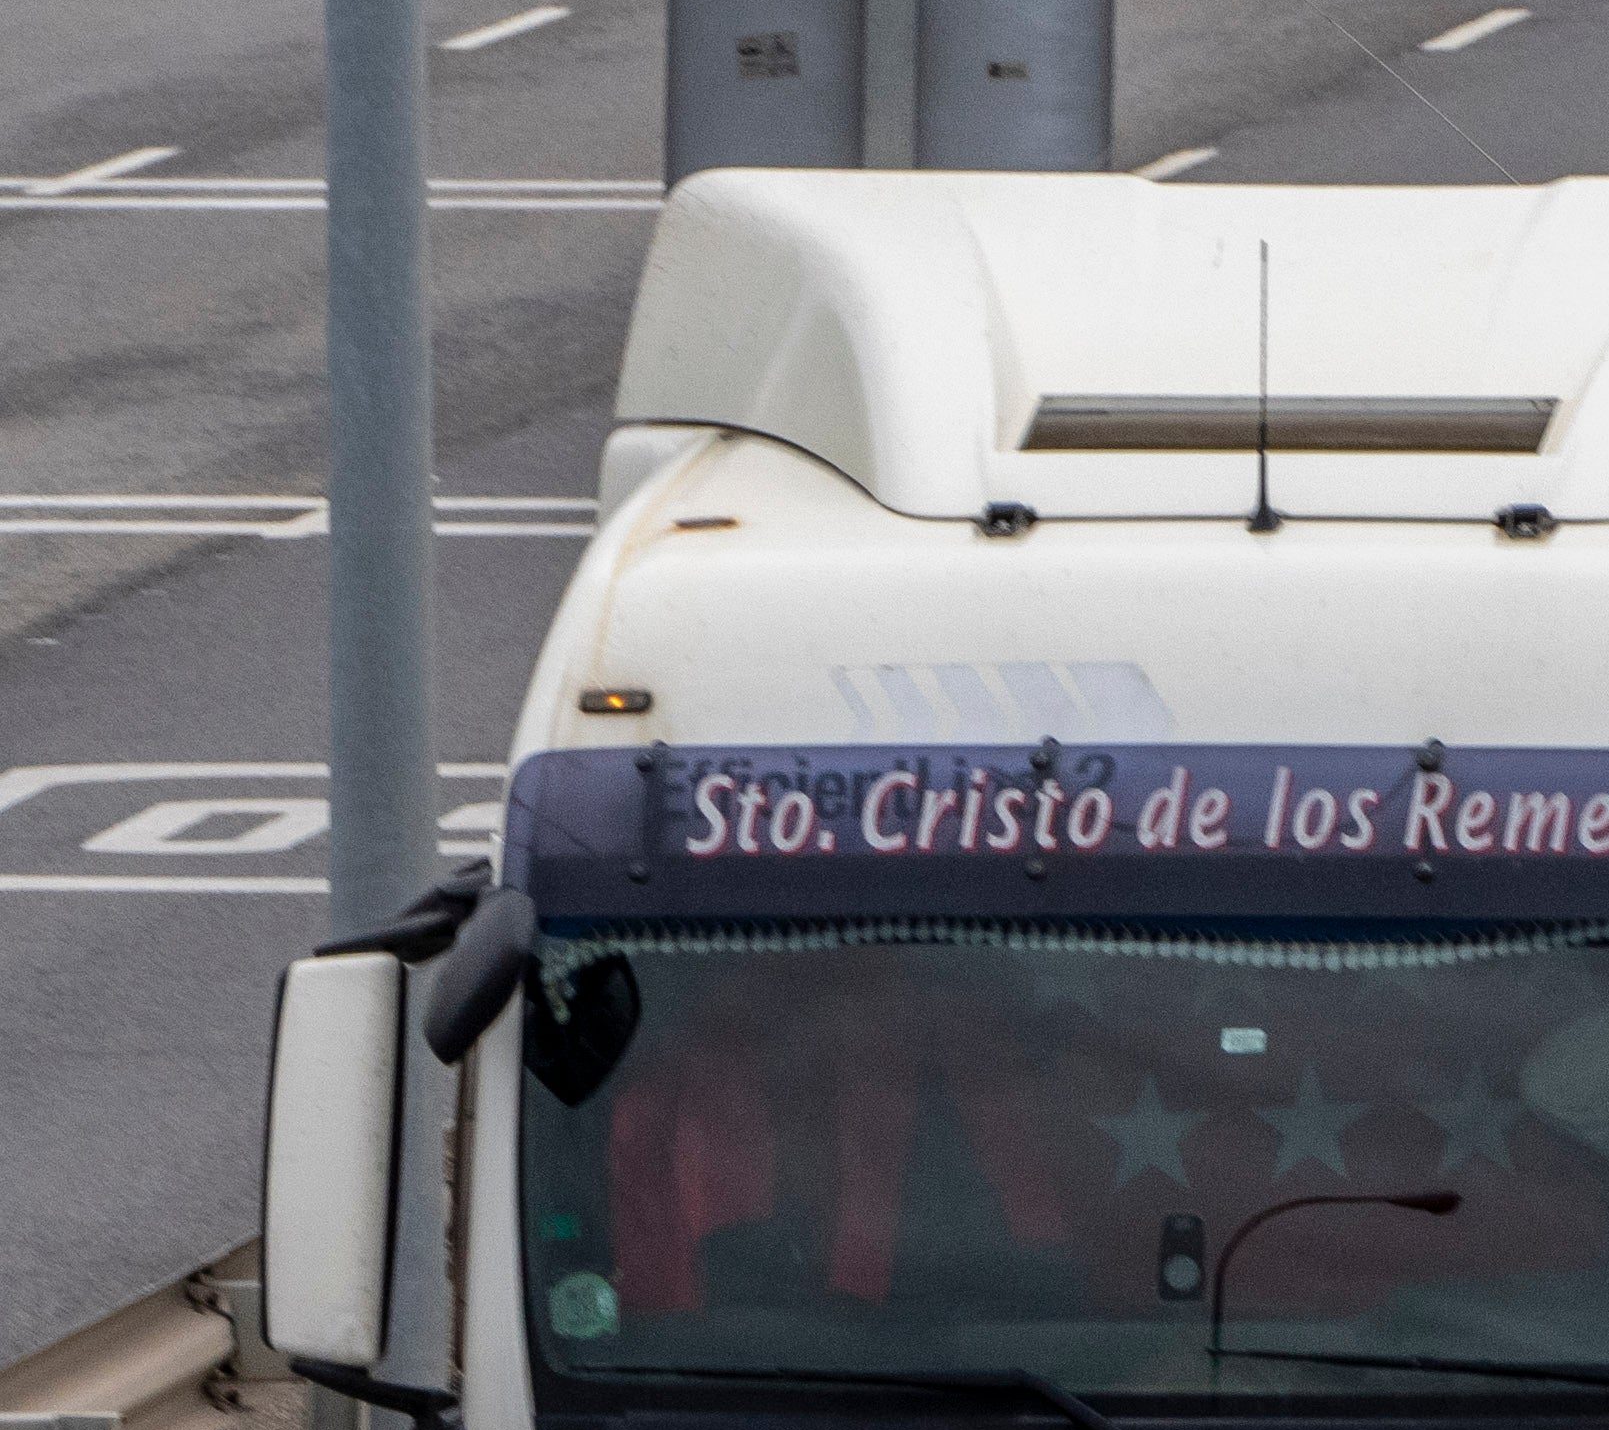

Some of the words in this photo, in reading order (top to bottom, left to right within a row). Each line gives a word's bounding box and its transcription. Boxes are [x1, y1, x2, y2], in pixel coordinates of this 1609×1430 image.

[686, 773, 837, 856] Sto.
[861, 768, 1113, 854] Cristo
[1136, 766, 1232, 852] de
[1264, 766, 1380, 852] los
